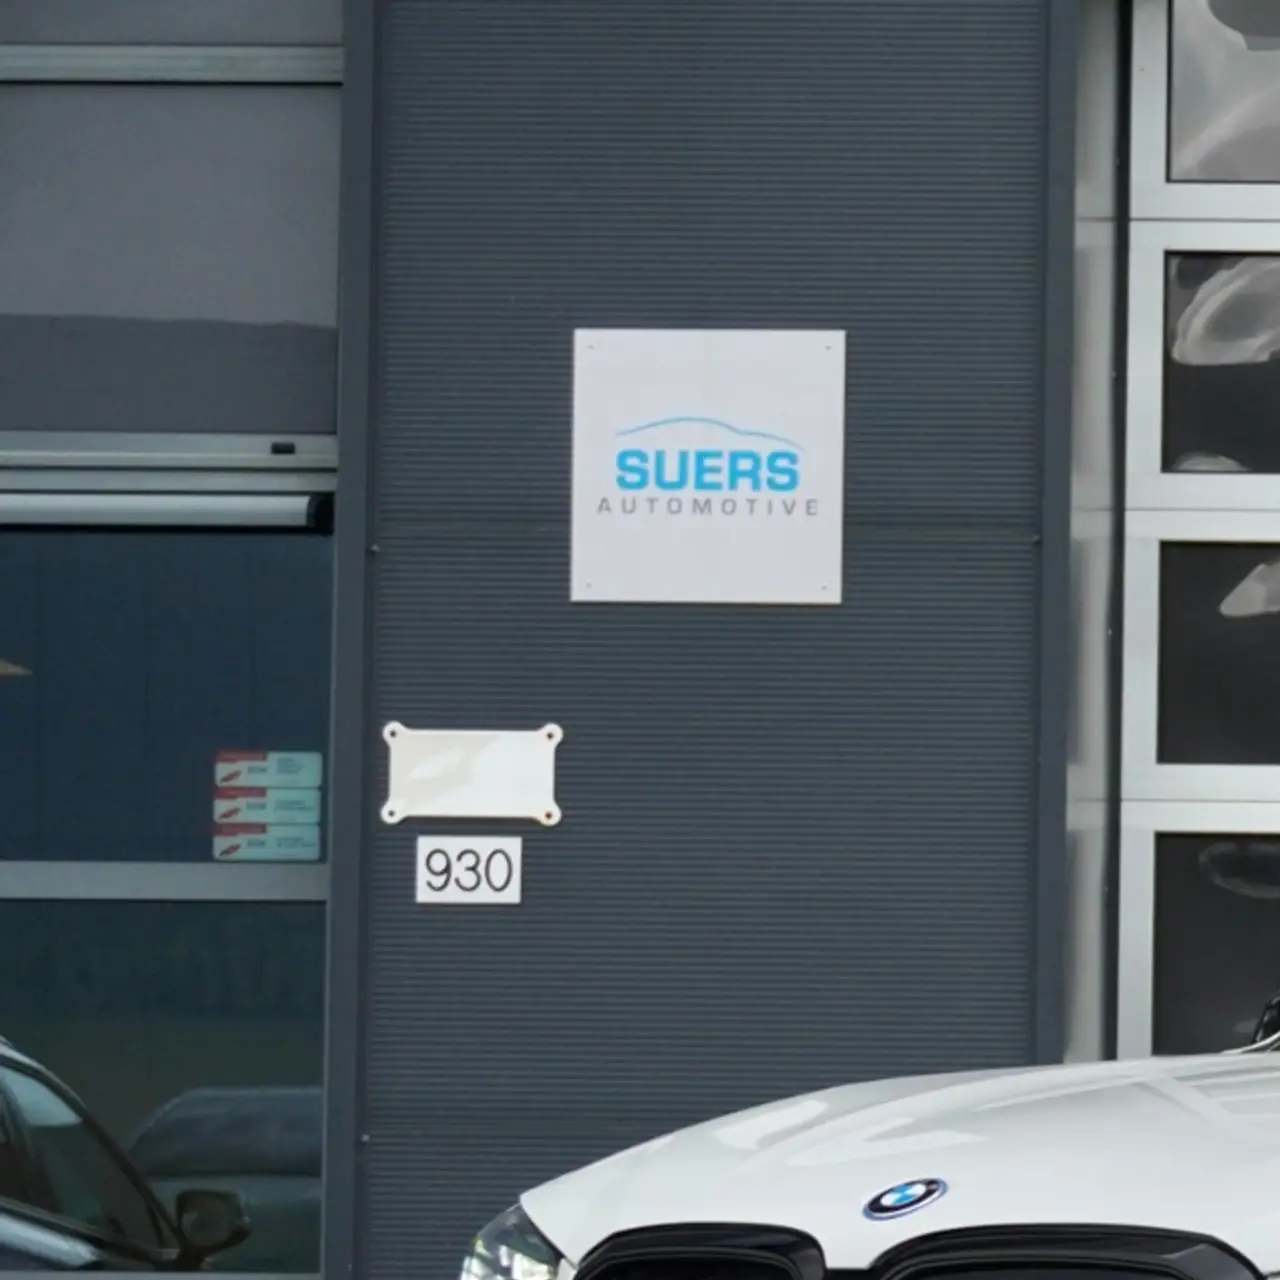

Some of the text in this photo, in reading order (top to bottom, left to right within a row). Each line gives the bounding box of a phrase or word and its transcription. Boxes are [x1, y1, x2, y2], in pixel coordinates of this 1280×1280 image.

[616, 449, 800, 492] SUERS
[597, 497, 818, 516] AUTOMOTIVE
[426, 848, 513, 892] 930
